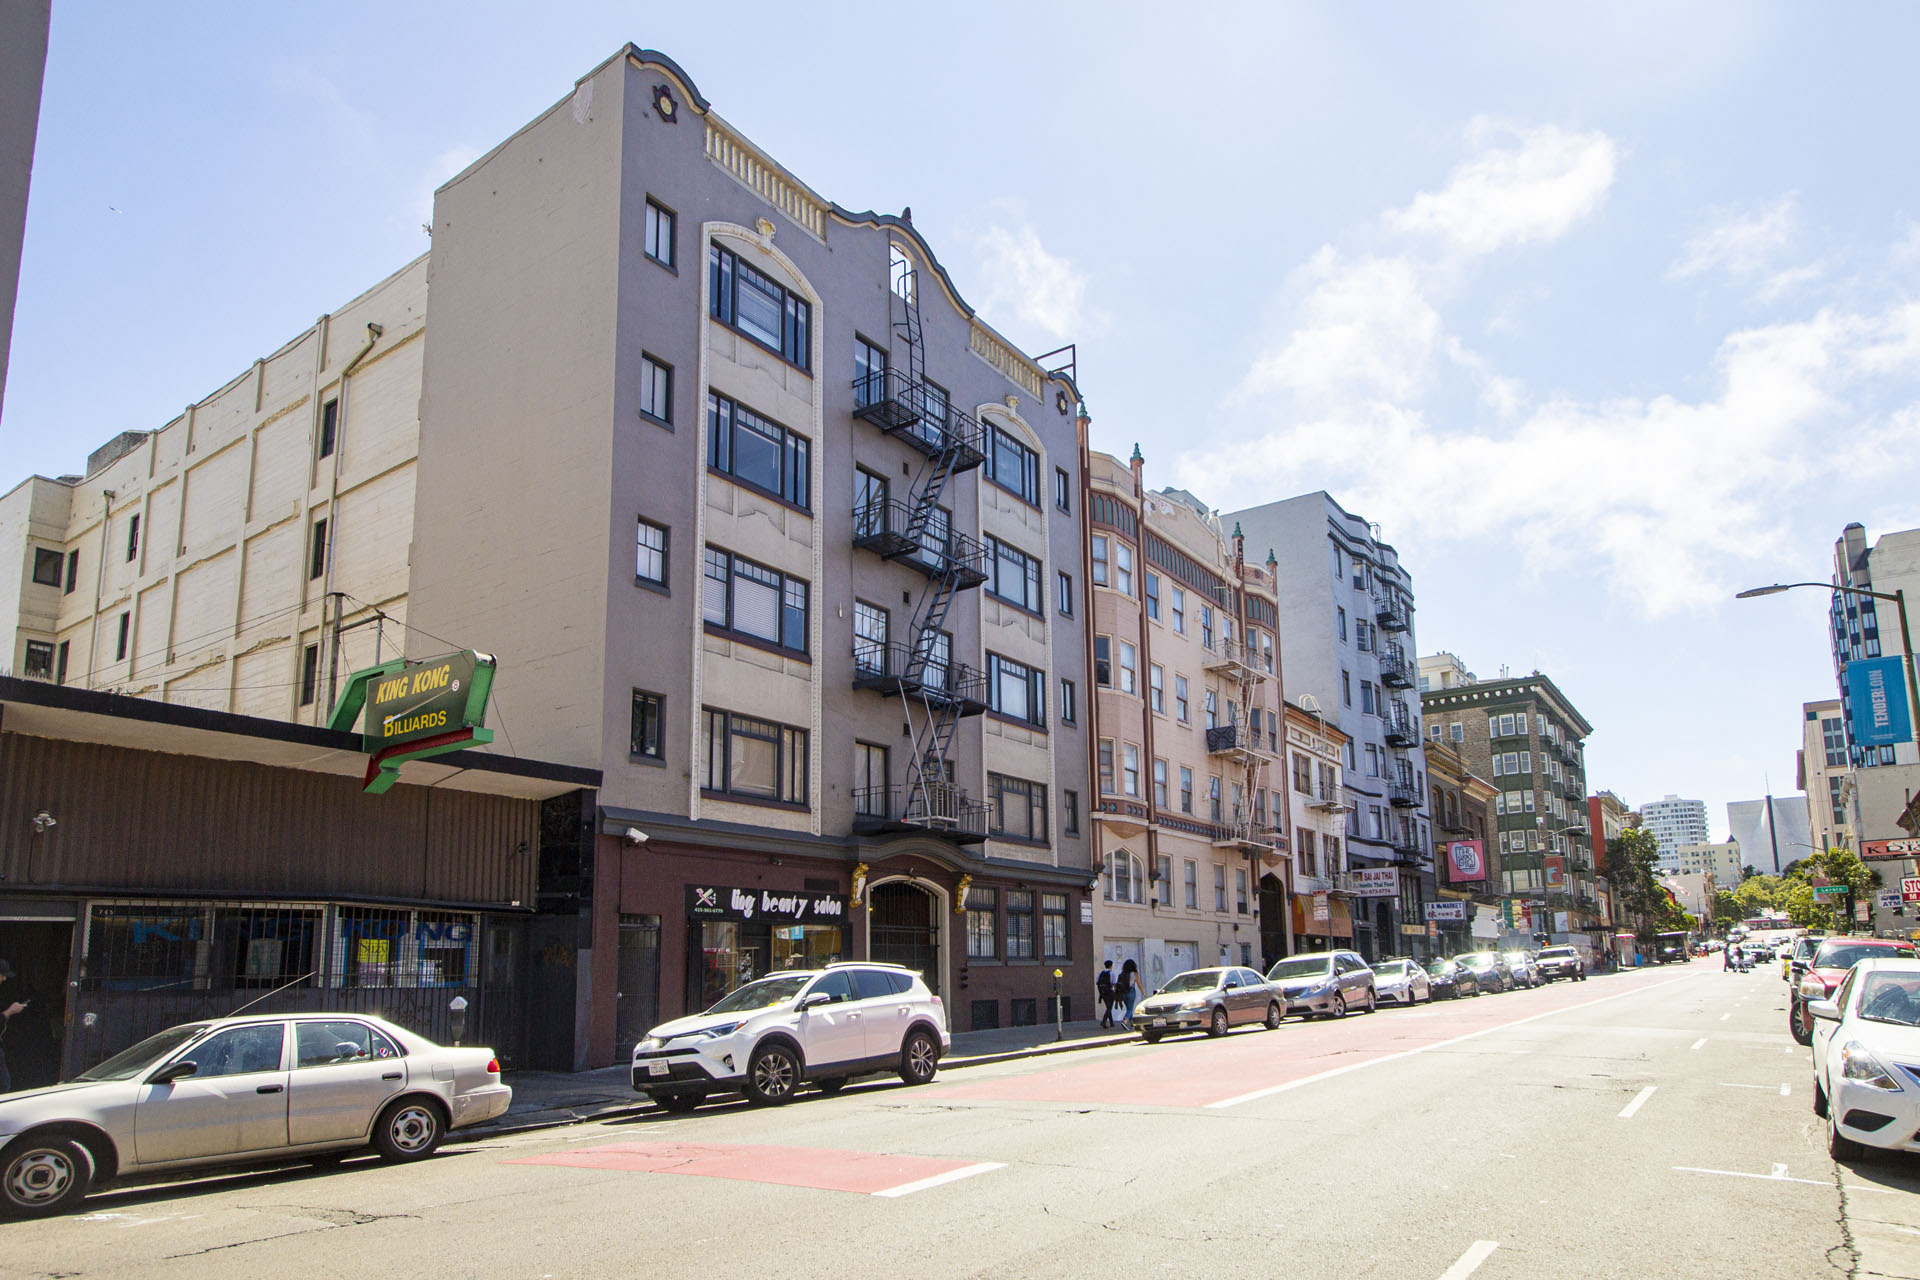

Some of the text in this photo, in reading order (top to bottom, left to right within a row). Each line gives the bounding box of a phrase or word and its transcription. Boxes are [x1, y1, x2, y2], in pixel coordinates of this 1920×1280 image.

[376, 664, 450, 704] KING KONG
[1868, 669, 1889, 728] TENDERLOIN
[383, 711, 447, 737] BILLIARDS
[1364, 871, 1393, 880] SAI JAI THAI
[731, 888, 756, 918] ling
[761, 890, 808, 919] beauty
[814, 894, 842, 916] salon
[342, 918, 473, 944] KONG
